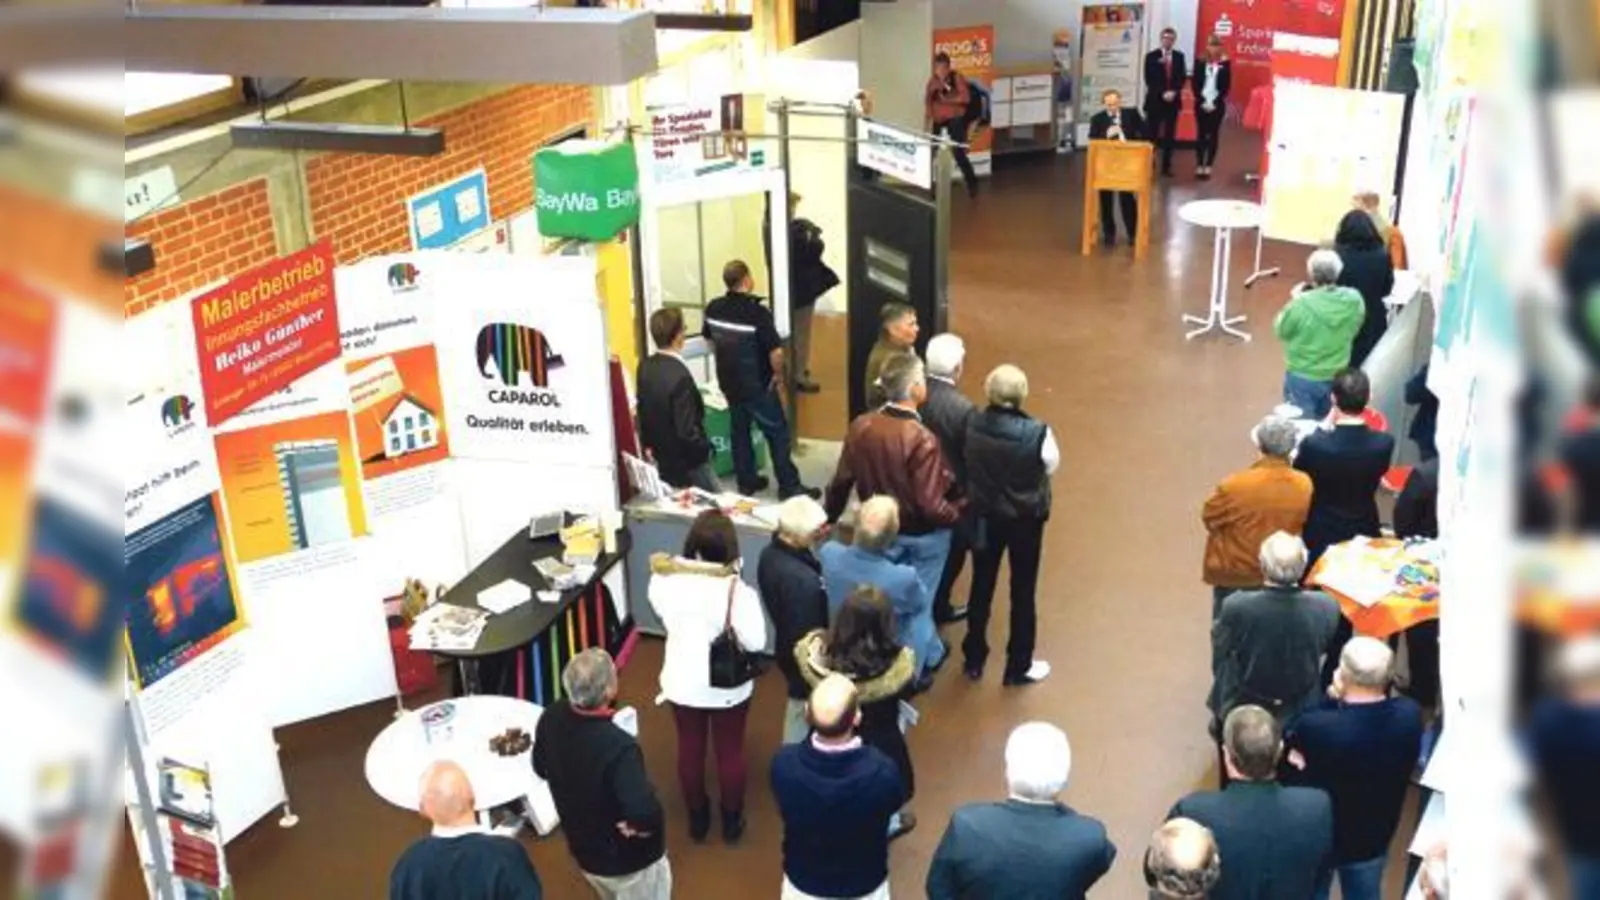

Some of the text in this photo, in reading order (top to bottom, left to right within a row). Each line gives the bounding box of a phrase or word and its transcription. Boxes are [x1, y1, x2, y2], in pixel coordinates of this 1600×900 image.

[536, 187, 600, 215] BayWa
[201, 253, 326, 329] Malerbetrieb
[214, 308, 325, 372] Heiko Günther
[488, 389, 561, 408] CAPAROL
[465, 413, 589, 436] Qualität erleben.
